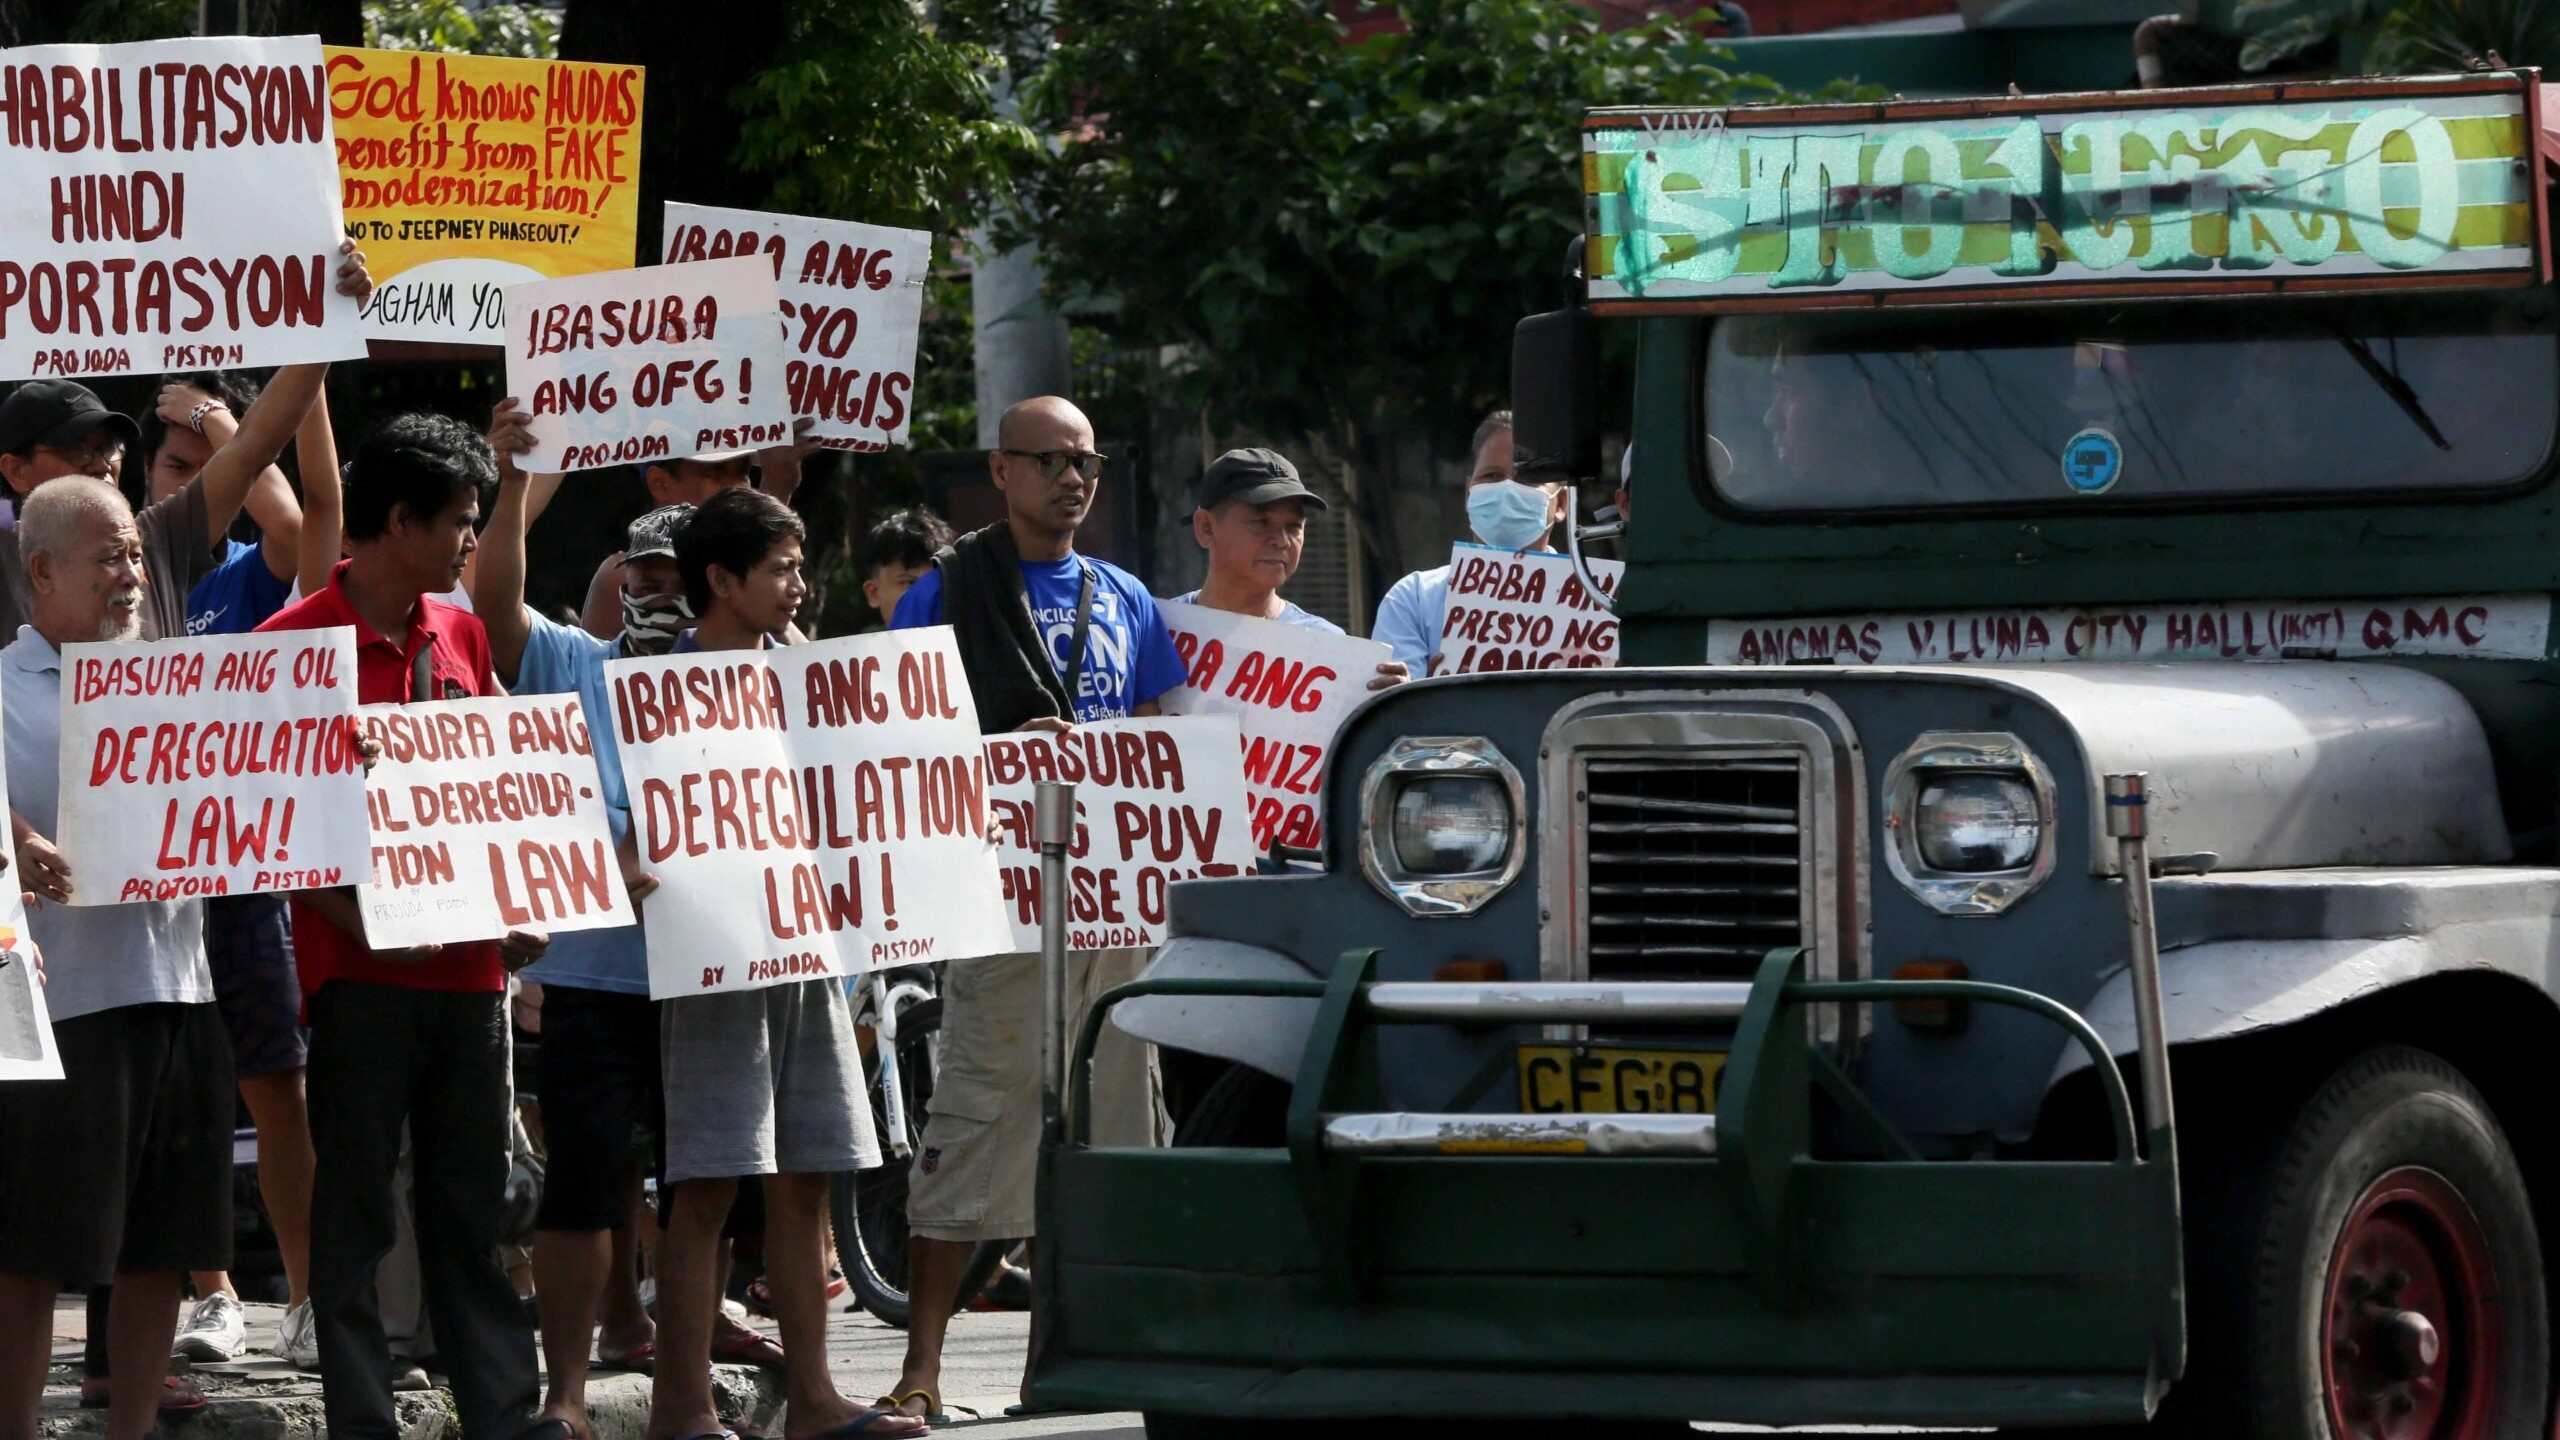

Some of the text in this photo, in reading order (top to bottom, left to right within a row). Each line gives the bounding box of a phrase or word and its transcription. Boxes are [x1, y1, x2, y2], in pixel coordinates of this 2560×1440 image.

[325, 55, 637, 127] God knows HUDAS
[459, 122, 537, 172] from
[545, 127, 629, 183] FAKE
[51, 171, 184, 243] HINDI
[342, 169, 613, 219] modernization!
[345, 219, 580, 245] NO TO JEEPNEY PHASEOUT!
[799, 240, 892, 290] ANG
[0, 255, 325, 339] PORTASYON
[360, 281, 505, 331] AGHAM YO
[527, 295, 718, 359] IBASURA
[33, 344, 243, 376] PROJODA PISTON
[533, 370, 617, 416] ANG
[560, 421, 785, 471] PROJODA PISTON
[1449, 557, 1621, 613] IBABA AN
[1032, 607, 1091, 623] NCILO
[1442, 606, 1619, 652] PRESYO NG
[2064, 612, 2147, 657] CITY
[2166, 610, 2266, 658] HALL
[2361, 606, 2489, 651] QMC
[74, 647, 338, 704] IBASURA ANG OIL
[615, 651, 959, 744] IBASURA ANG OIL
[1225, 651, 1336, 712] ANG
[89, 714, 364, 787] DEREGULATION
[508, 701, 594, 756] ANG
[983, 731, 1185, 793] IBASURA
[1241, 733, 1322, 794] NIZ
[156, 795, 295, 870] LAW!
[642, 755, 984, 863] DEREGULATION
[1114, 801, 1222, 862] PUV
[253, 867, 341, 891] PISTON
[487, 838, 613, 926] LAW
[748, 953, 829, 981] PROJODA
[872, 937, 935, 964] PISTON
[1067, 925, 1151, 949] ROJODA
[1669, 1059, 1727, 1115] 8
